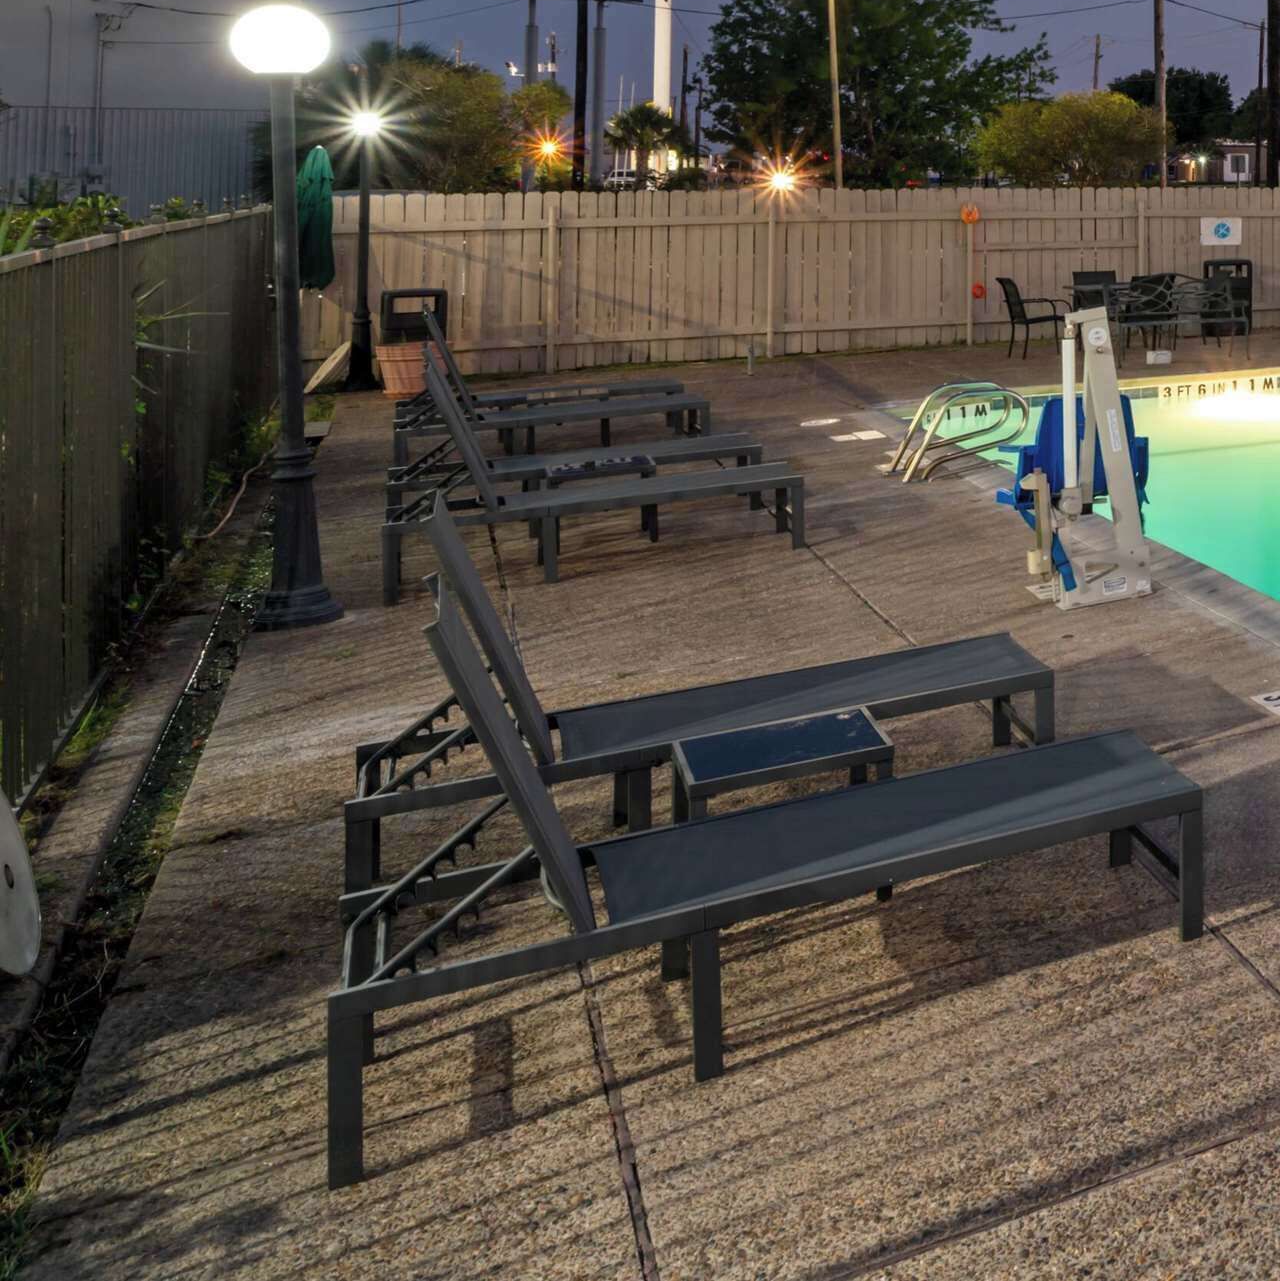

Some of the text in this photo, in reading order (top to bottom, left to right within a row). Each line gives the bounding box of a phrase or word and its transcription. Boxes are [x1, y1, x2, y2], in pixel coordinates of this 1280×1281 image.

[1163, 386, 1172, 398] 3
[1177, 384, 1191, 397] FT
[1198, 383, 1207, 395] 6
[1212, 382, 1226, 393] IN
